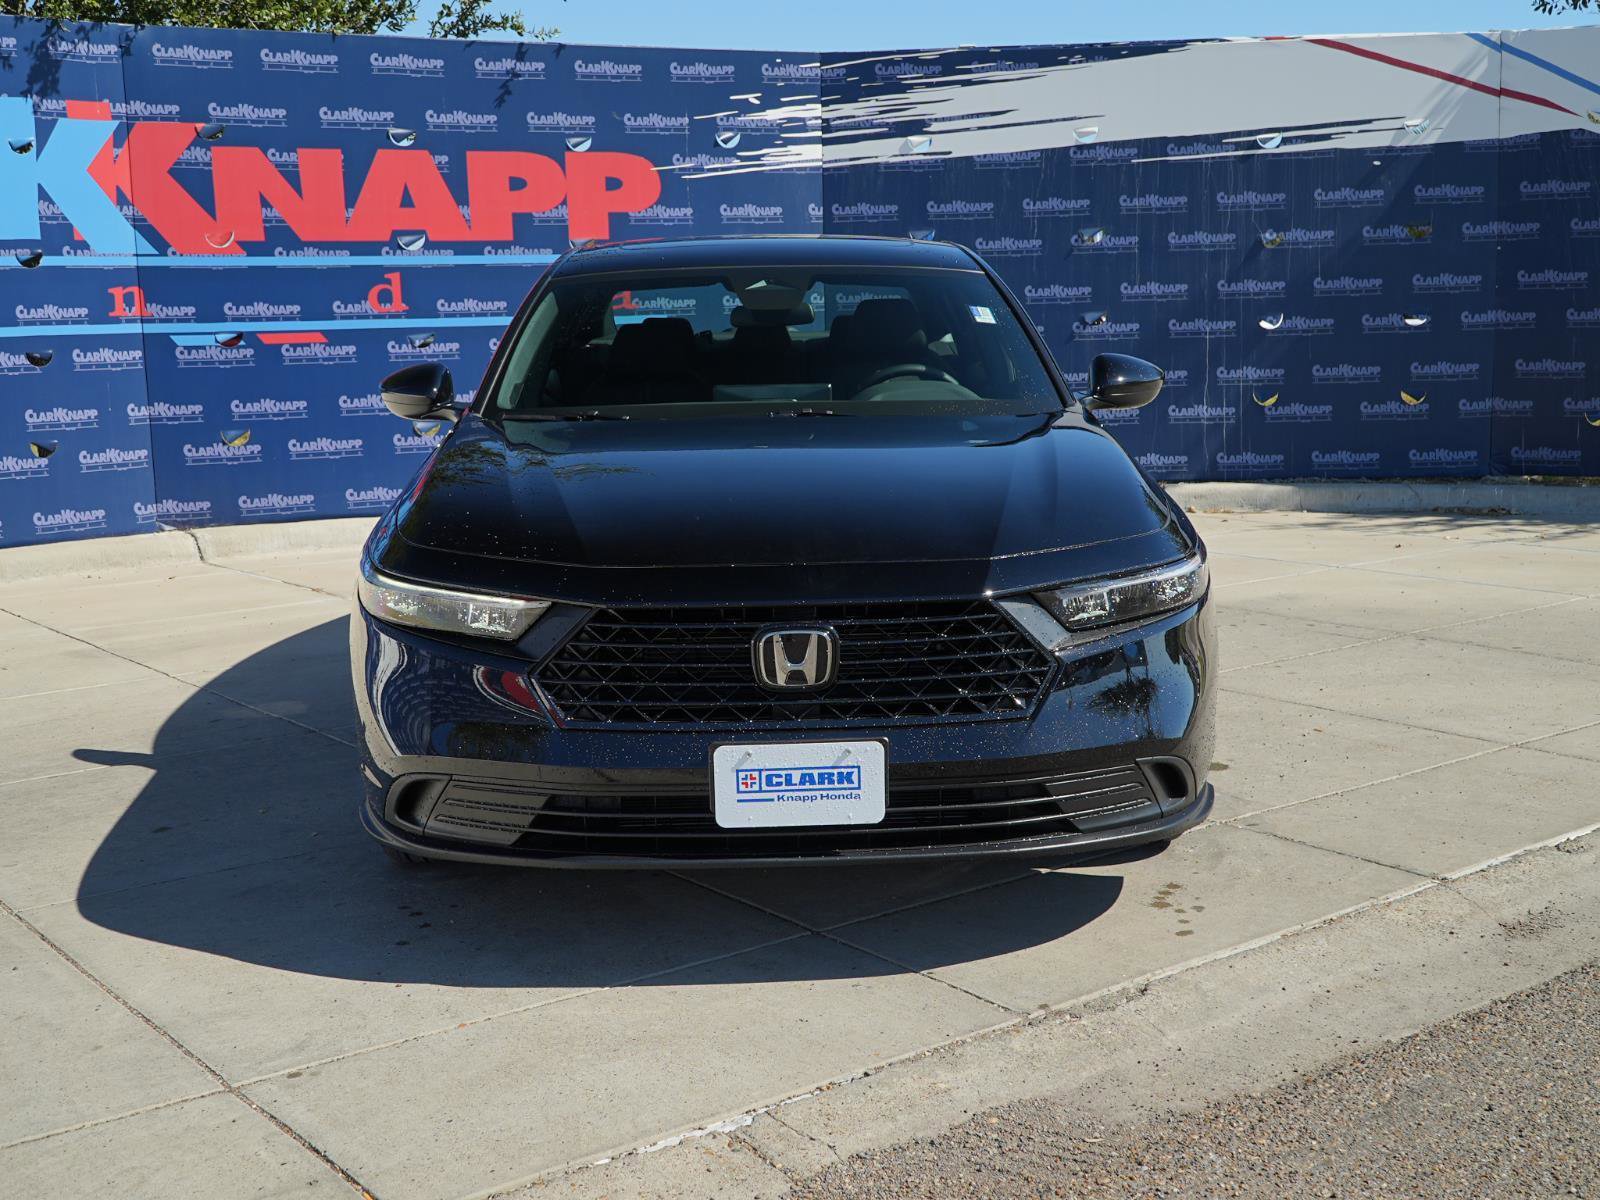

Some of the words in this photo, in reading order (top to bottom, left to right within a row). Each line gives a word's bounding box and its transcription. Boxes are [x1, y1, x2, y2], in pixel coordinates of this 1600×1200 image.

[765, 770, 855, 788] CLARK
[777, 794, 818, 803] Knapp
[820, 792, 861, 801] Honda
